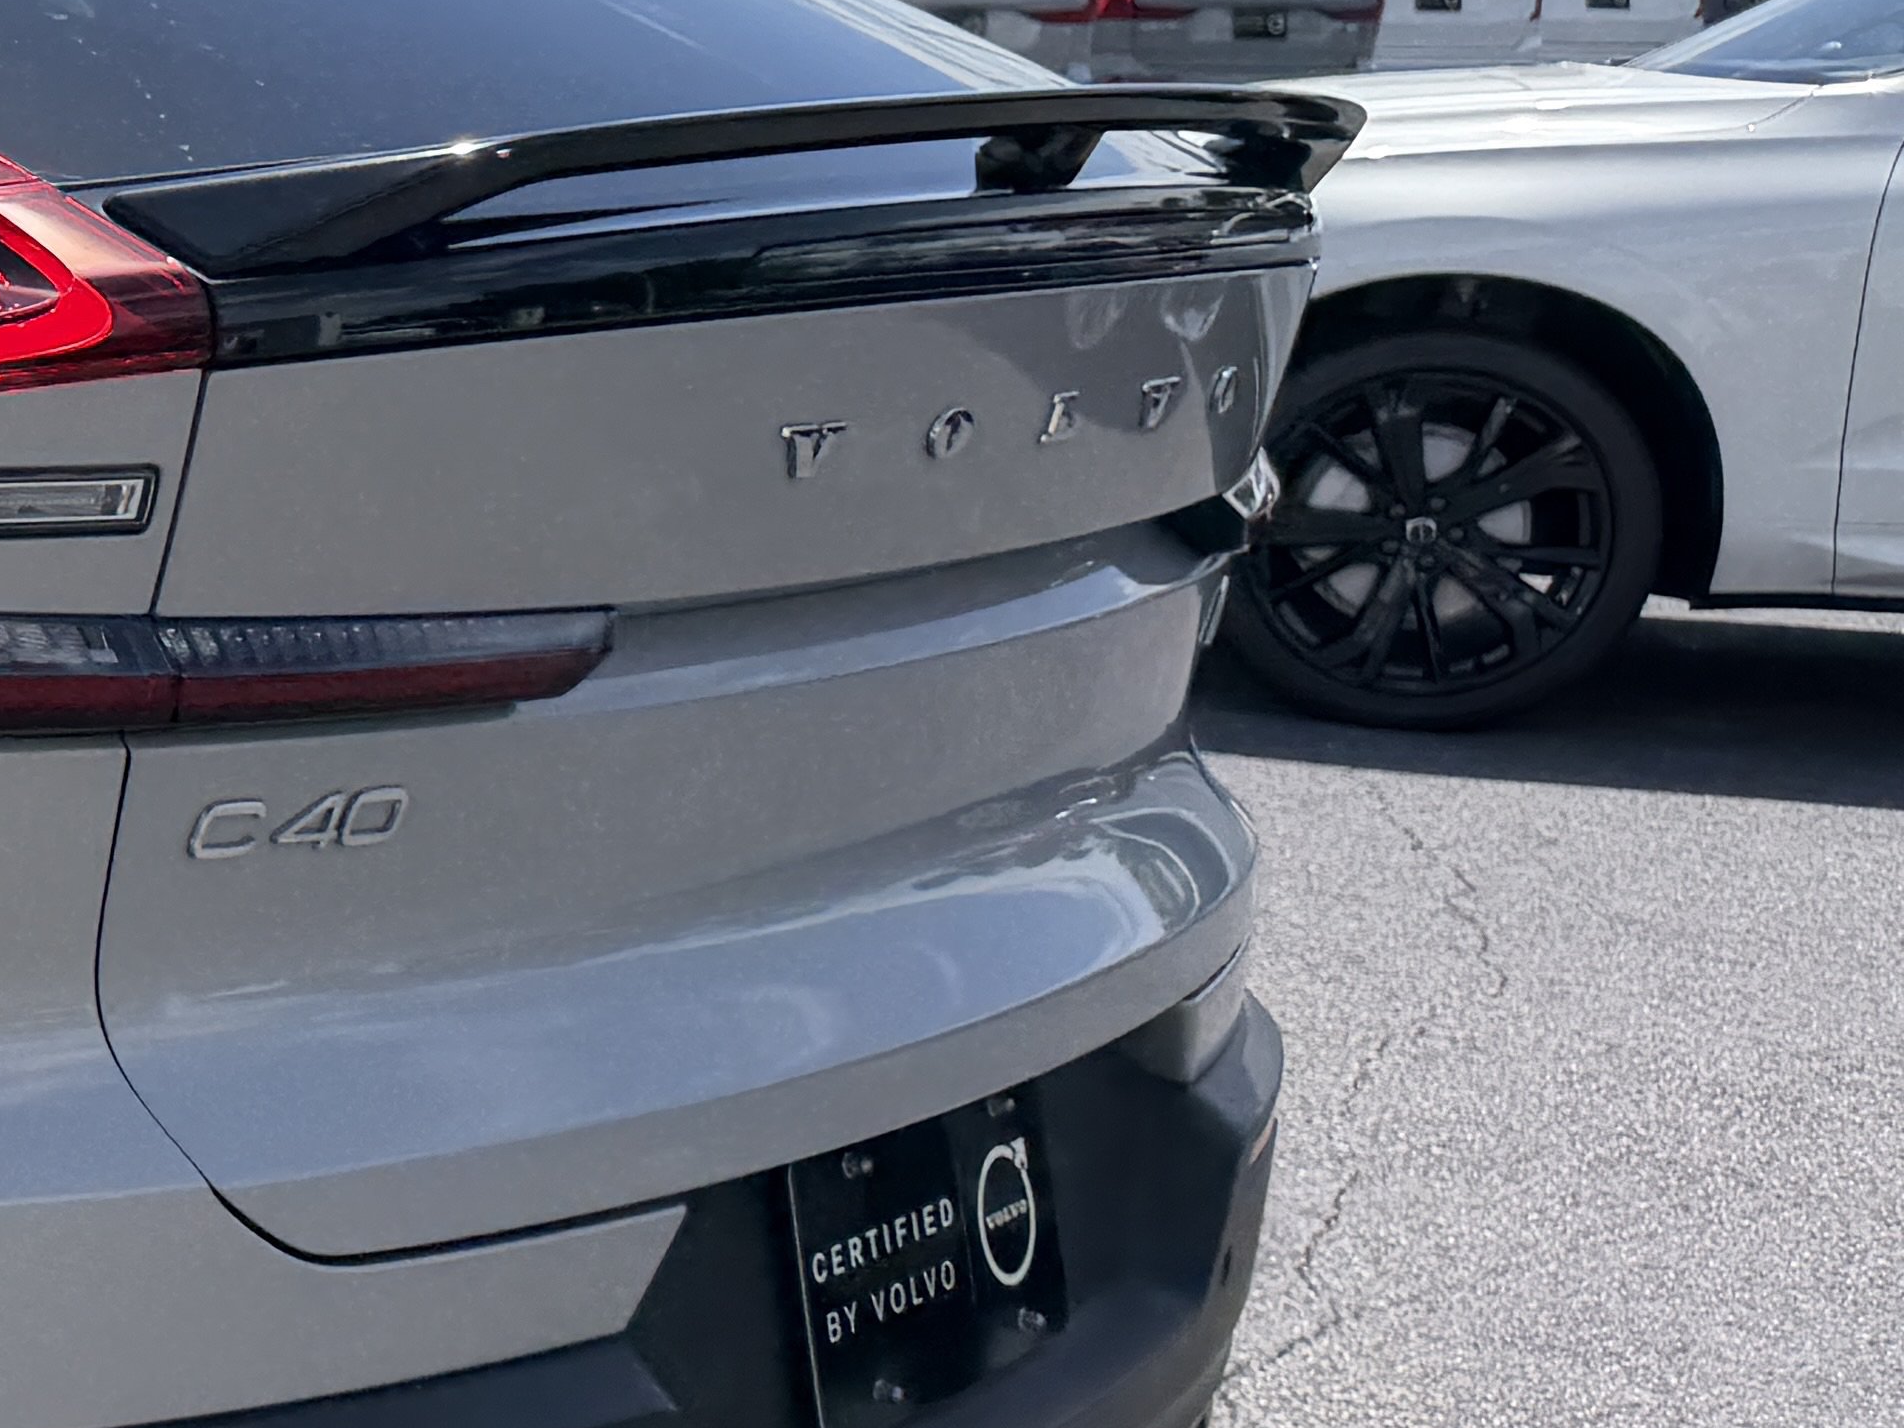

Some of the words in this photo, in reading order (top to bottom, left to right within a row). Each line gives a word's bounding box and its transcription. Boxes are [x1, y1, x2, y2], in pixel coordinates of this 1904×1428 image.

[780, 365, 1238, 478] VOLVO
[187, 785, 409, 859] C40
[811, 1197, 954, 1283] CERTIFIED
[825, 1303, 859, 1344] BY
[871, 1260, 957, 1323] VOLVO
